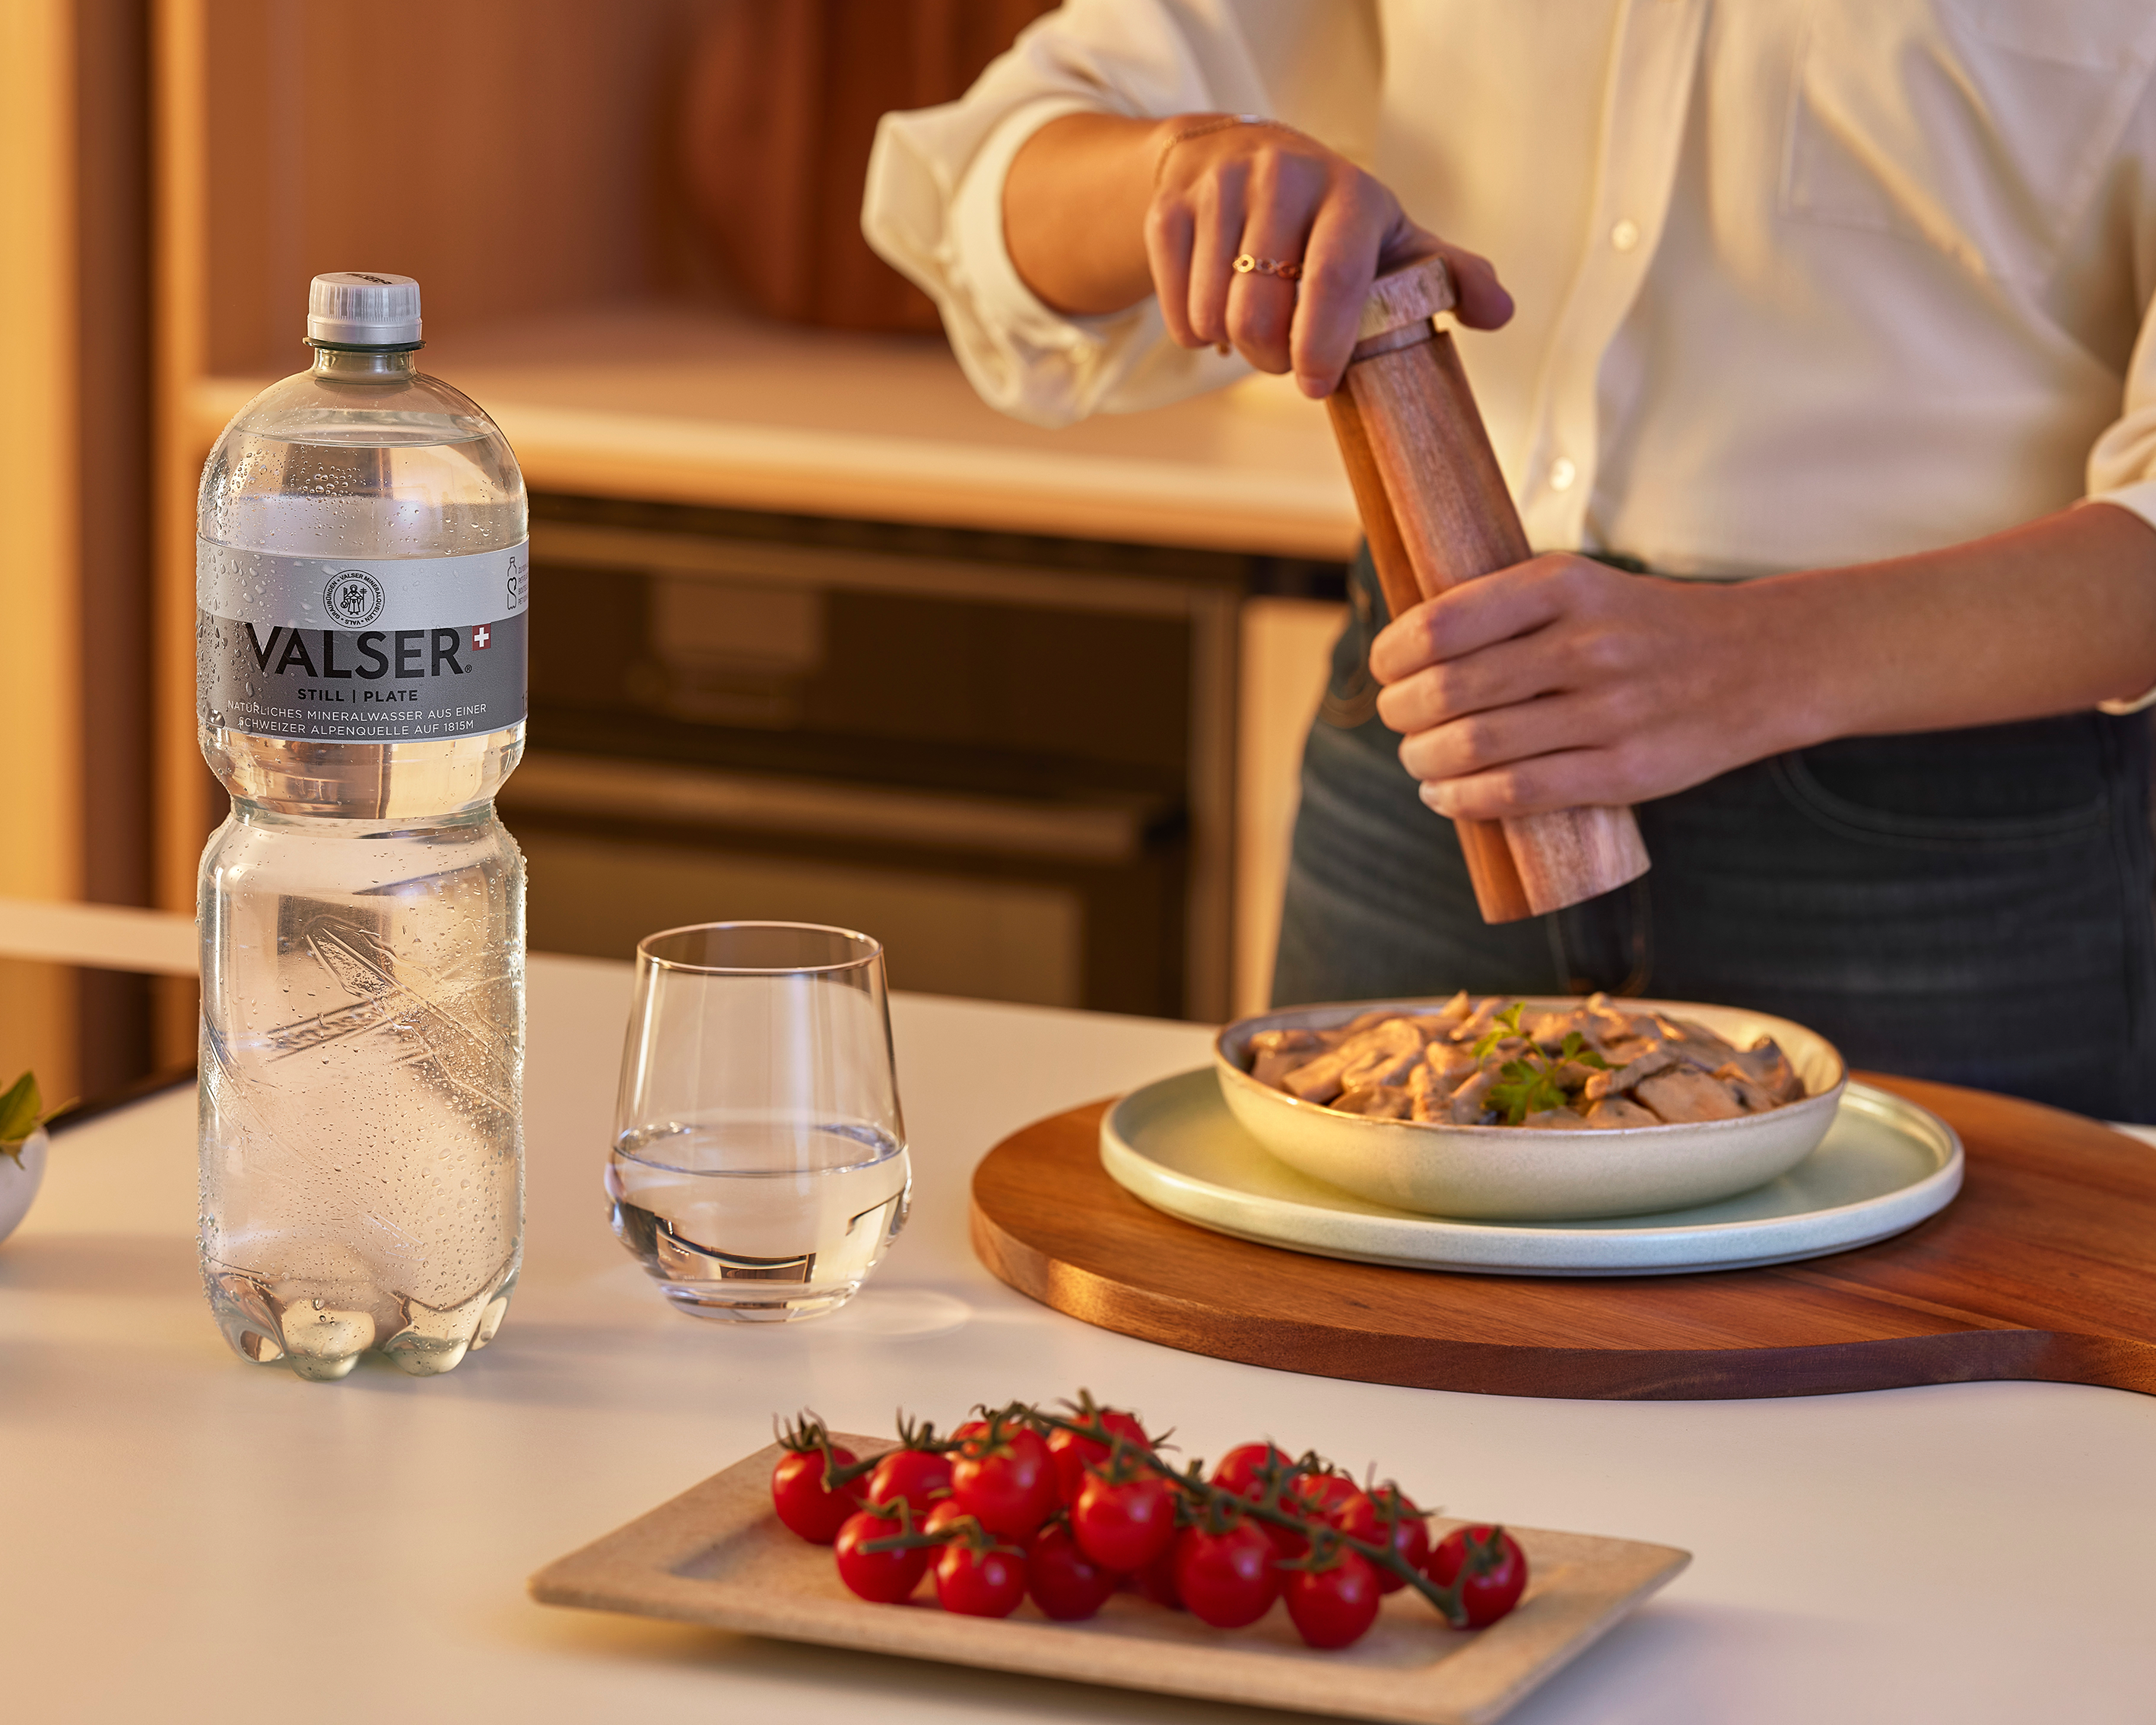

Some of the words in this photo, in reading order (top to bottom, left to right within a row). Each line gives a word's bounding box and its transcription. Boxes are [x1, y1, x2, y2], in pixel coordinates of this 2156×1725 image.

[325, 580, 341, 619] GRAUBÜNDEN
[364, 576, 382, 622] MINERALQUELLEN
[297, 688, 345, 702] STILL
[364, 689, 418, 702] PLATE
[227, 700, 302, 719] NATÜRLICHES
[307, 710, 423, 722] MINERALWASSER
[427, 708, 452, 720] AUS
[456, 704, 487, 716] EINER
[238, 716, 306, 733] SCHWEIZER
[310, 725, 409, 736] ALPENQUELLE
[414, 723, 440, 734] AUF
[443, 720, 474, 732] 1815M
